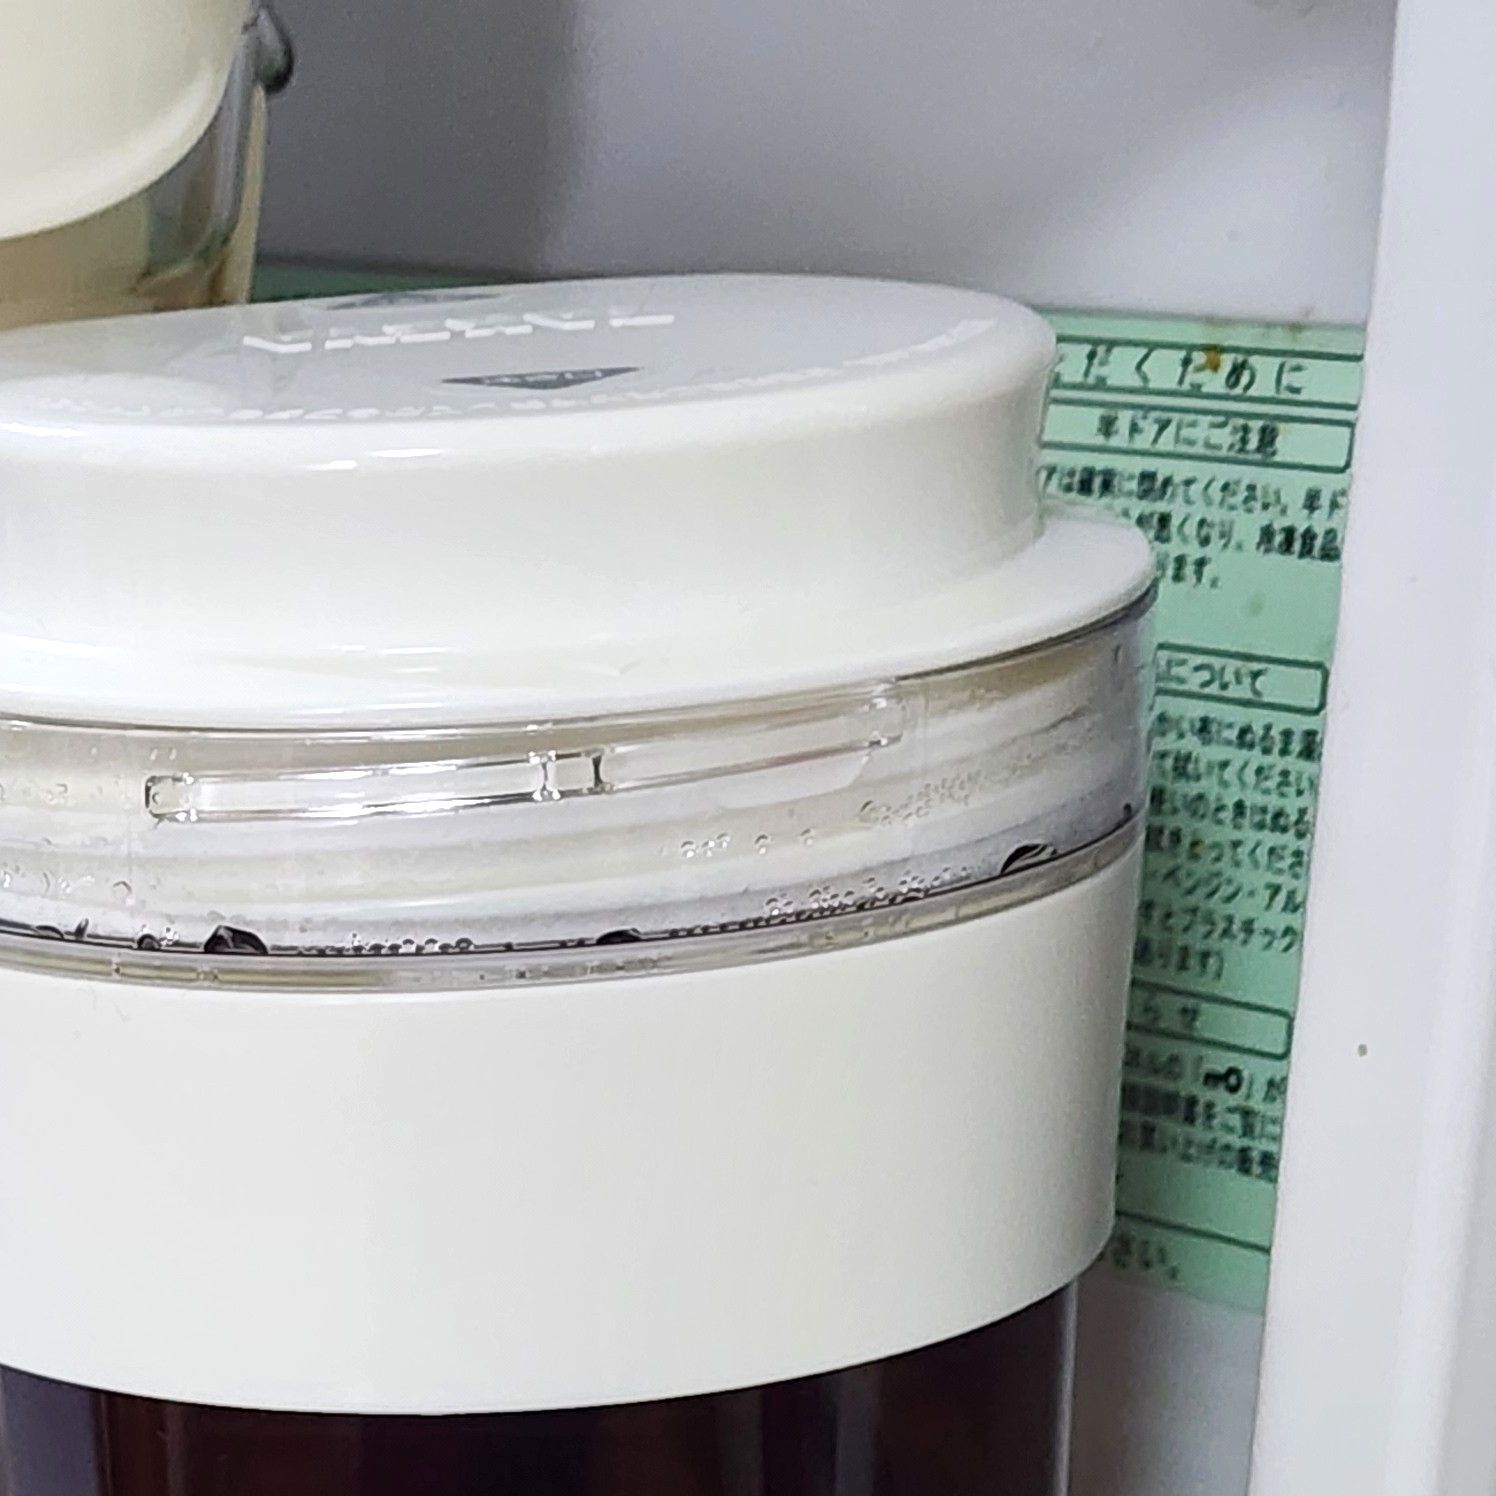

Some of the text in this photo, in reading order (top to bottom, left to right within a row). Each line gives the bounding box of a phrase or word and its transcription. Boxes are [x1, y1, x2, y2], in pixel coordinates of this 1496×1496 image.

[1054, 344, 1307, 395] だくために
